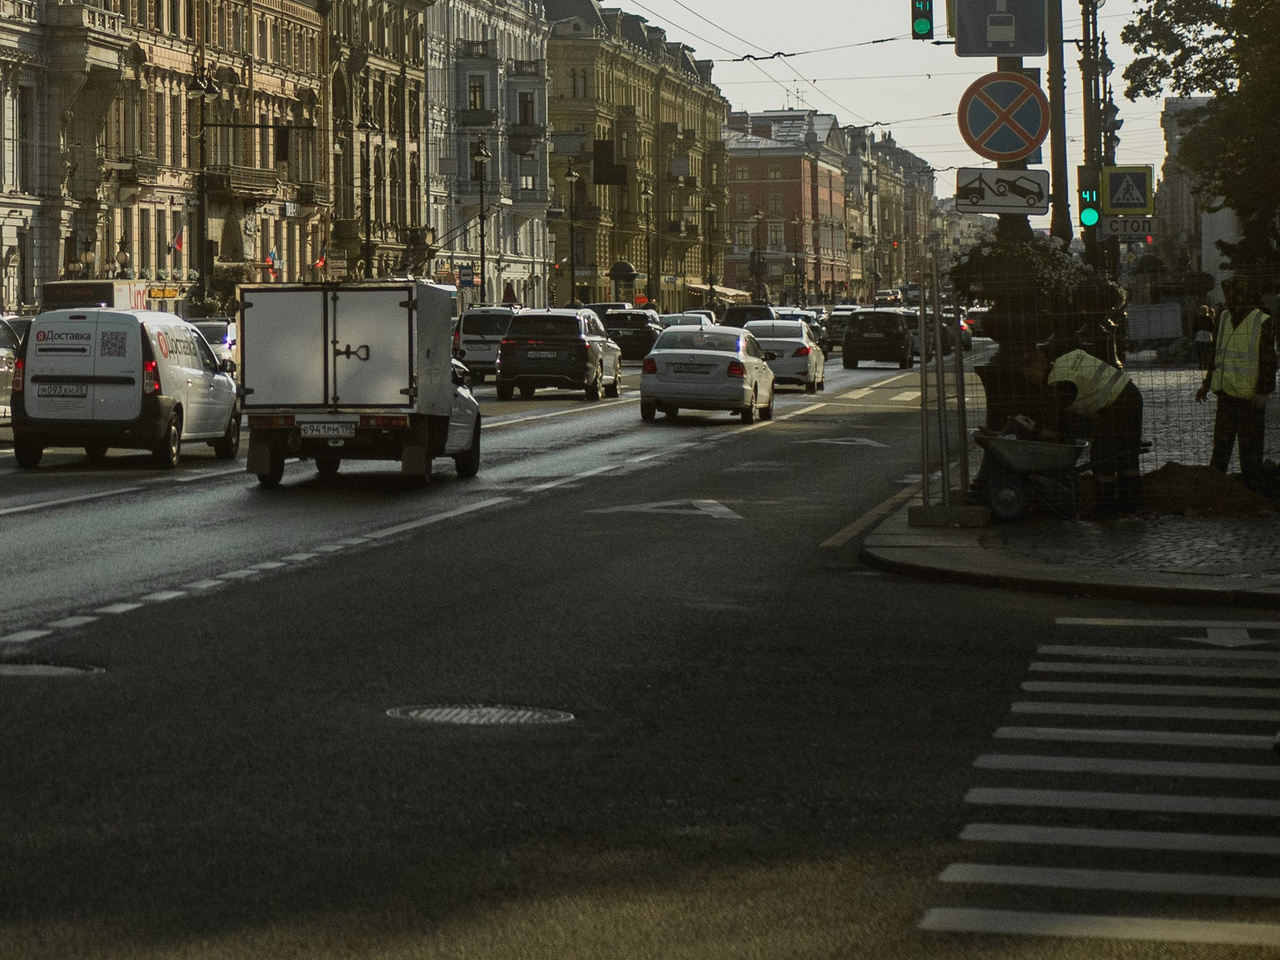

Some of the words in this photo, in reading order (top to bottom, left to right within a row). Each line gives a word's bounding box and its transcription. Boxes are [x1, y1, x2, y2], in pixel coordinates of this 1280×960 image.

[916, 1, 930, 11] 41
[1082, 190, 1097, 202] 41
[1109, 220, 1151, 232] СТОП
[46, 330, 91, 341] Доставка
